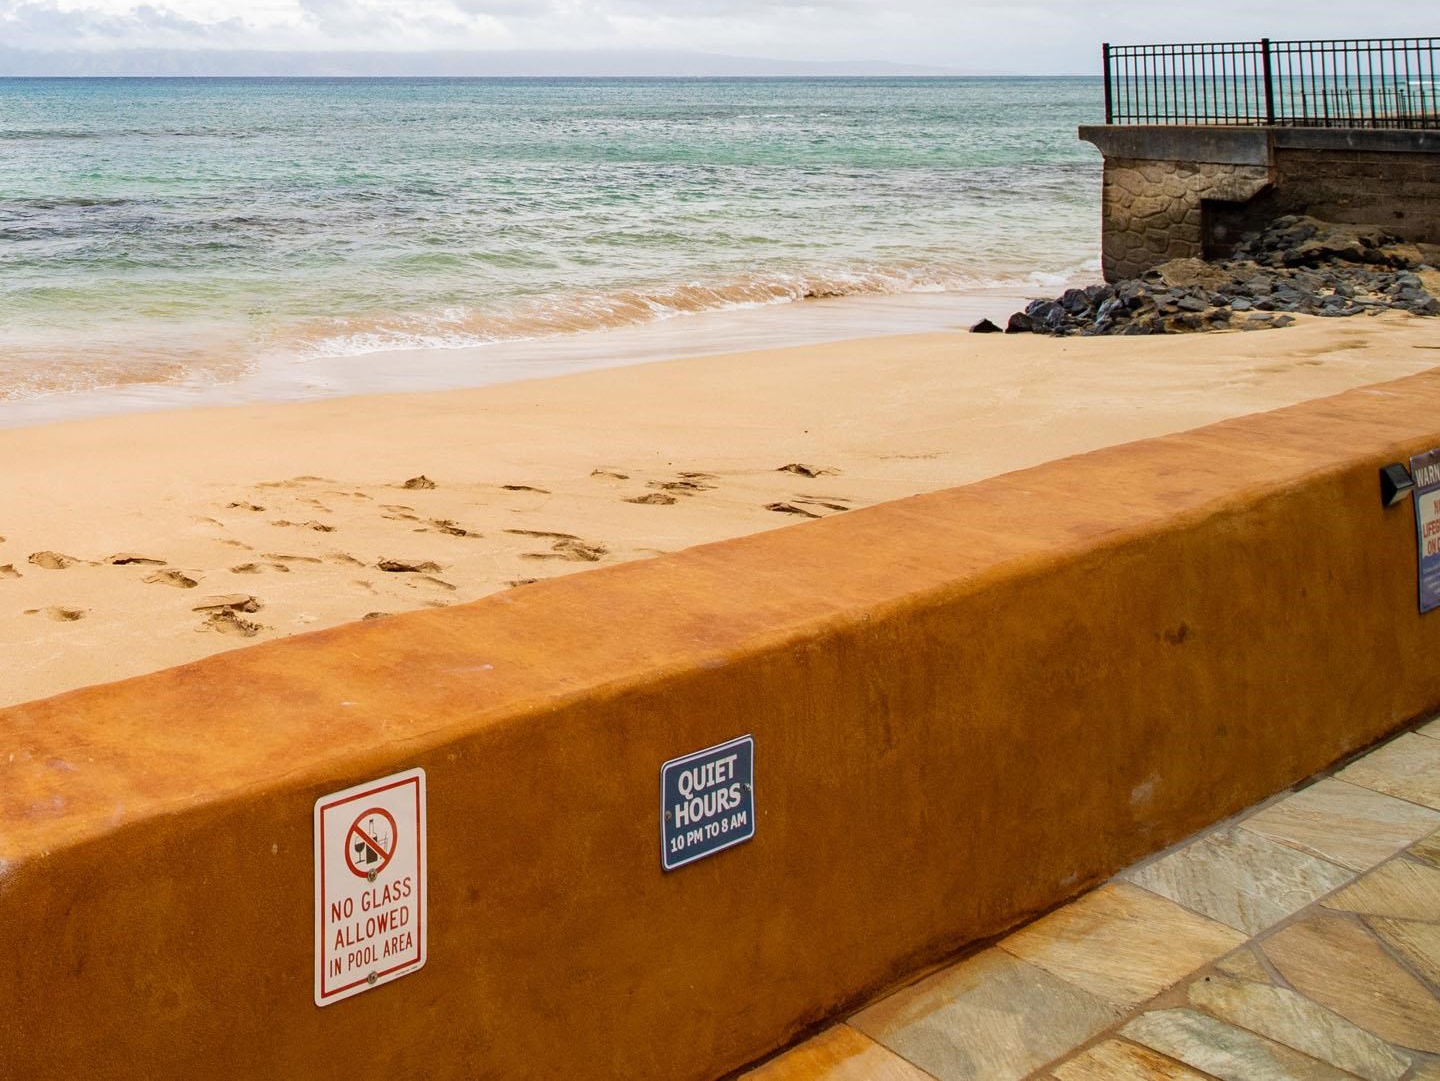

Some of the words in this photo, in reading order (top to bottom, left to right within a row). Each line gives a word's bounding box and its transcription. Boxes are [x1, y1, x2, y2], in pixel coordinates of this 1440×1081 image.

[678, 754, 737, 800] QUIET
[675, 782, 741, 828] HOURS
[671, 835, 685, 853] 10
[687, 827, 703, 847] PM
[705, 821, 719, 839] TO
[721, 818, 728, 833] 8
[730, 810, 747, 830] AM
[331, 897, 354, 923] NO
[361, 877, 412, 912] GLASS
[334, 906, 409, 951] ALLOWED
[330, 957, 342, 978] IN
[348, 944, 378, 971] POOL
[383, 931, 413, 958] AREA
